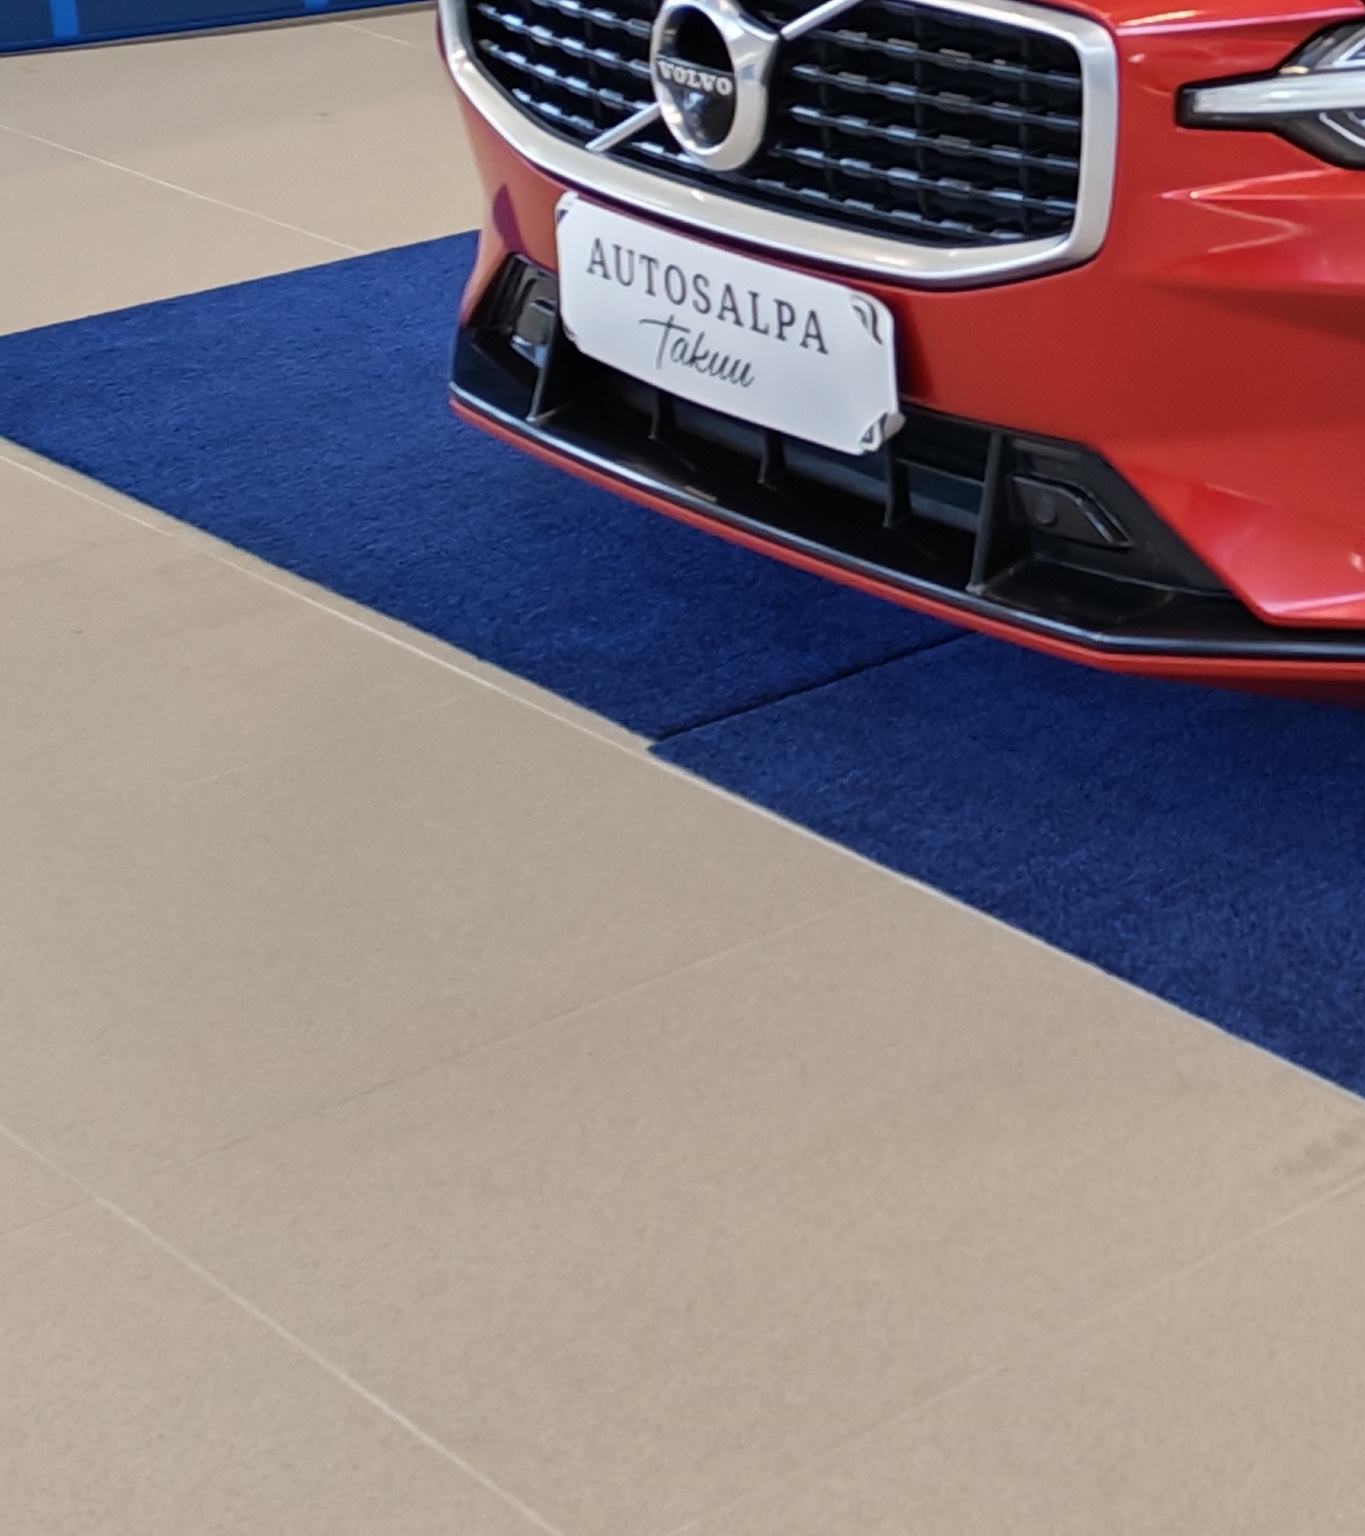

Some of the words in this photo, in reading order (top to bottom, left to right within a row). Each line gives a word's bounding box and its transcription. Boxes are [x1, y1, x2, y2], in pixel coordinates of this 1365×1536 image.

[658, 60, 733, 96] VOLVO
[586, 237, 829, 355] AUTOSALPA
[639, 314, 755, 388] Takuu
